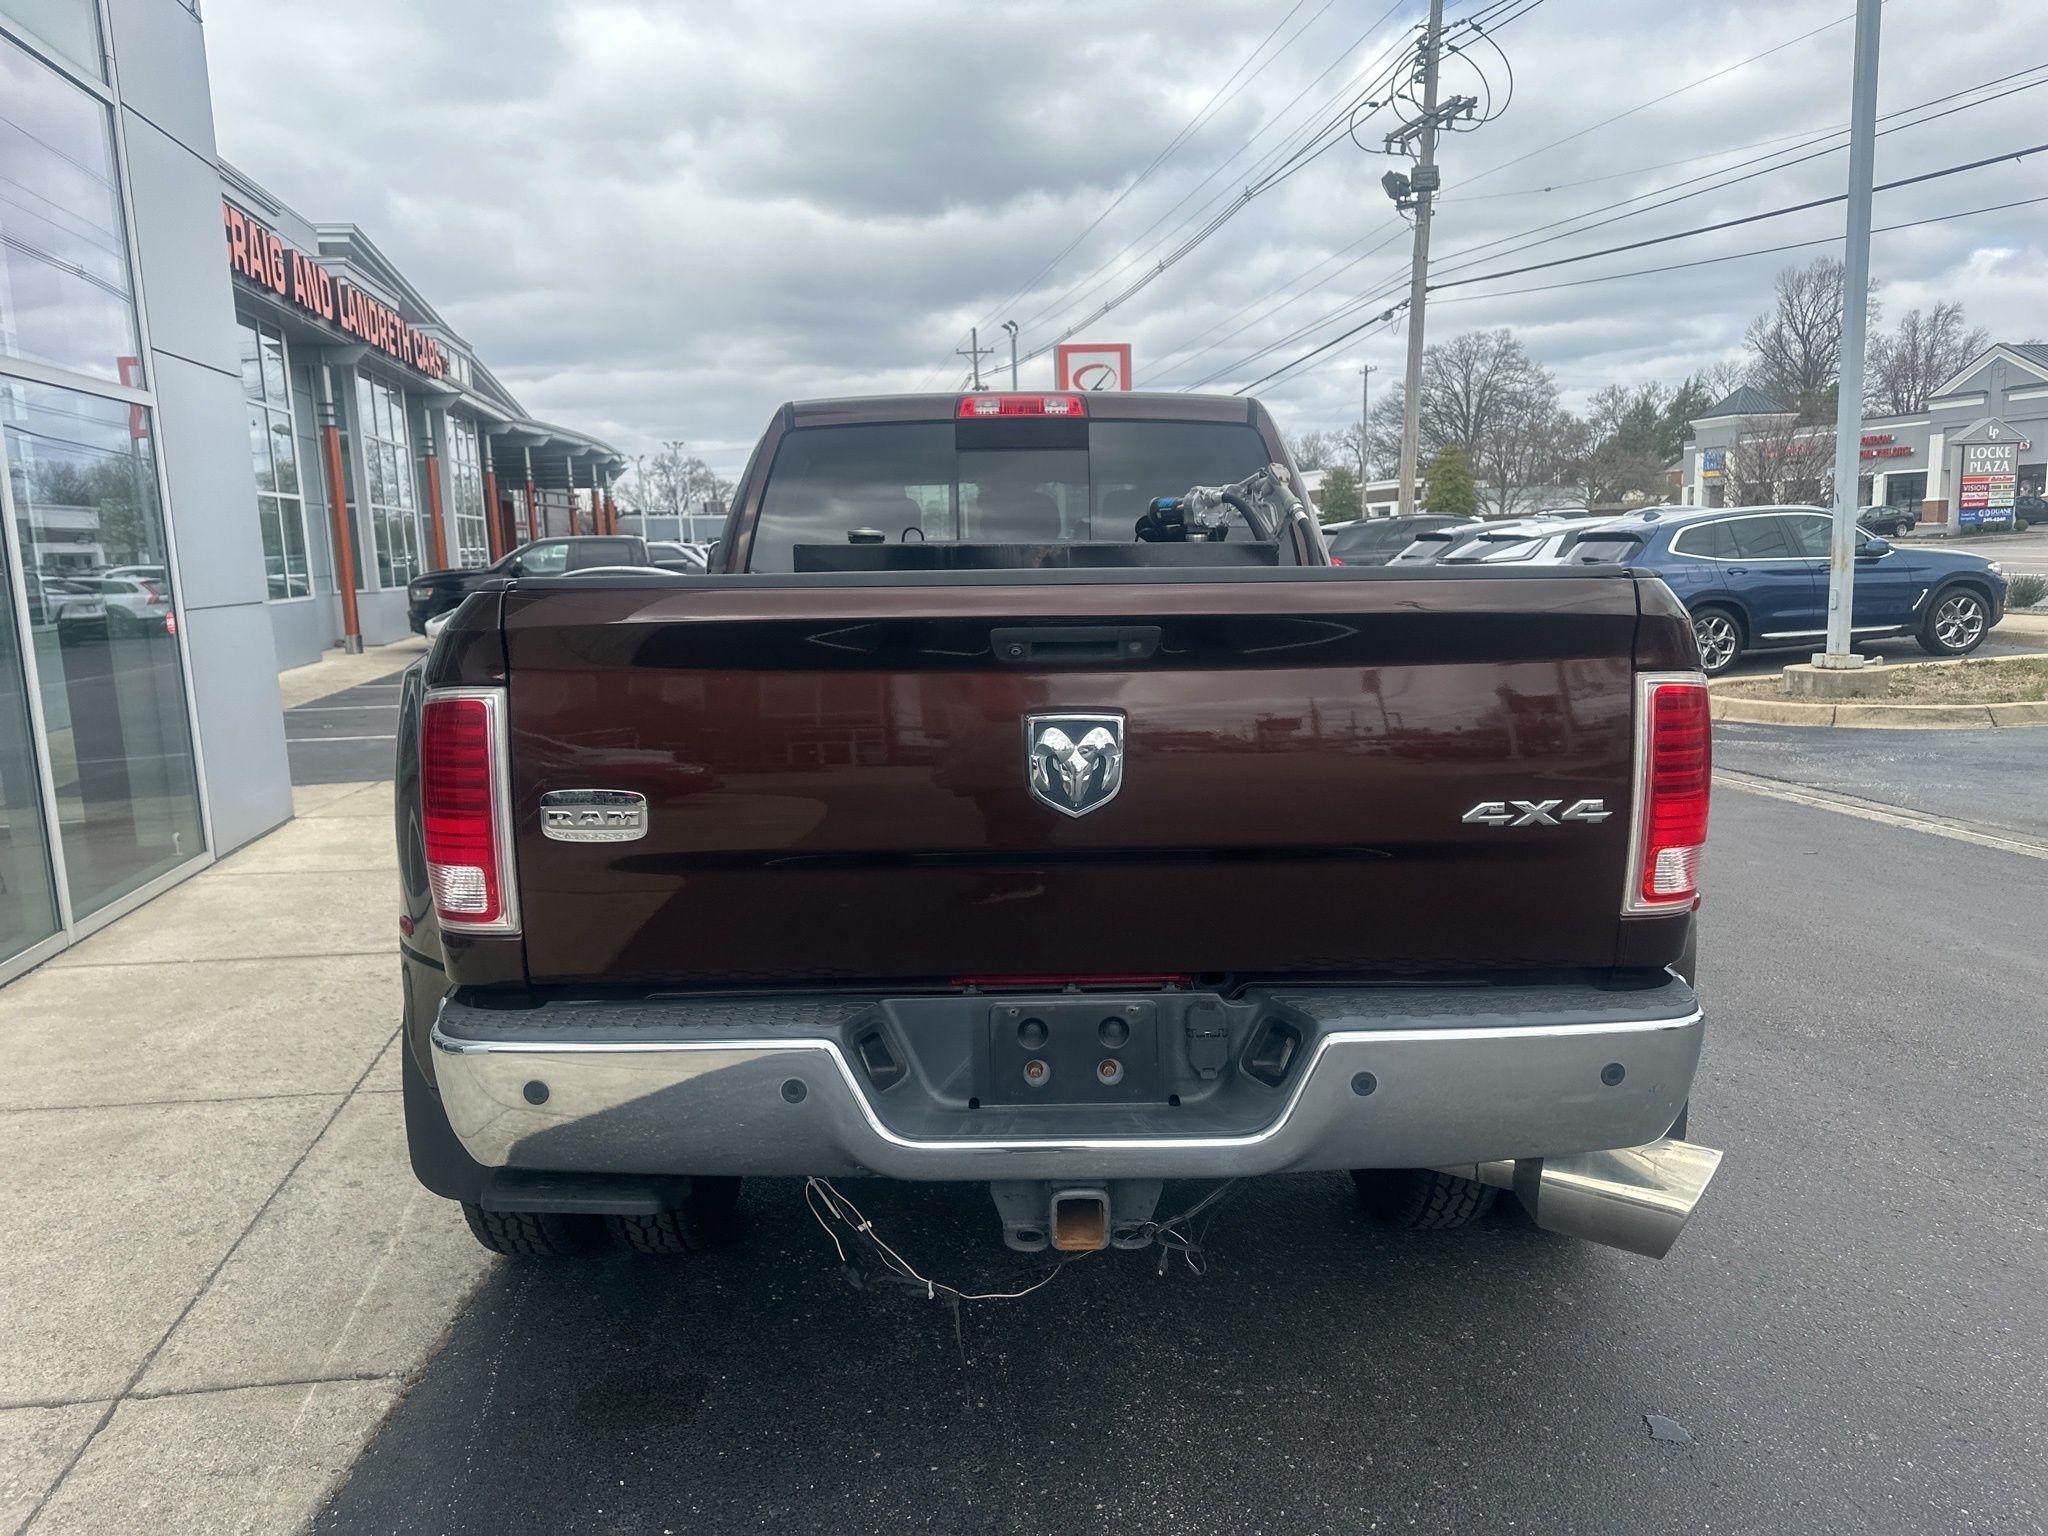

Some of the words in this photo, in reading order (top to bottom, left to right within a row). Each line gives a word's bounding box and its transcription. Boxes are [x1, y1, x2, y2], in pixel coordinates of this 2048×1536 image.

[292, 250, 334, 321] AND
[336, 277, 413, 365] LANDRETH
[413, 329, 443, 380] CARS
[1970, 446, 2011, 459] LOCKE
[1970, 460, 2010, 473] PLAZA
[1963, 484, 1987, 492] VISION
[547, 810, 639, 826] RAM
